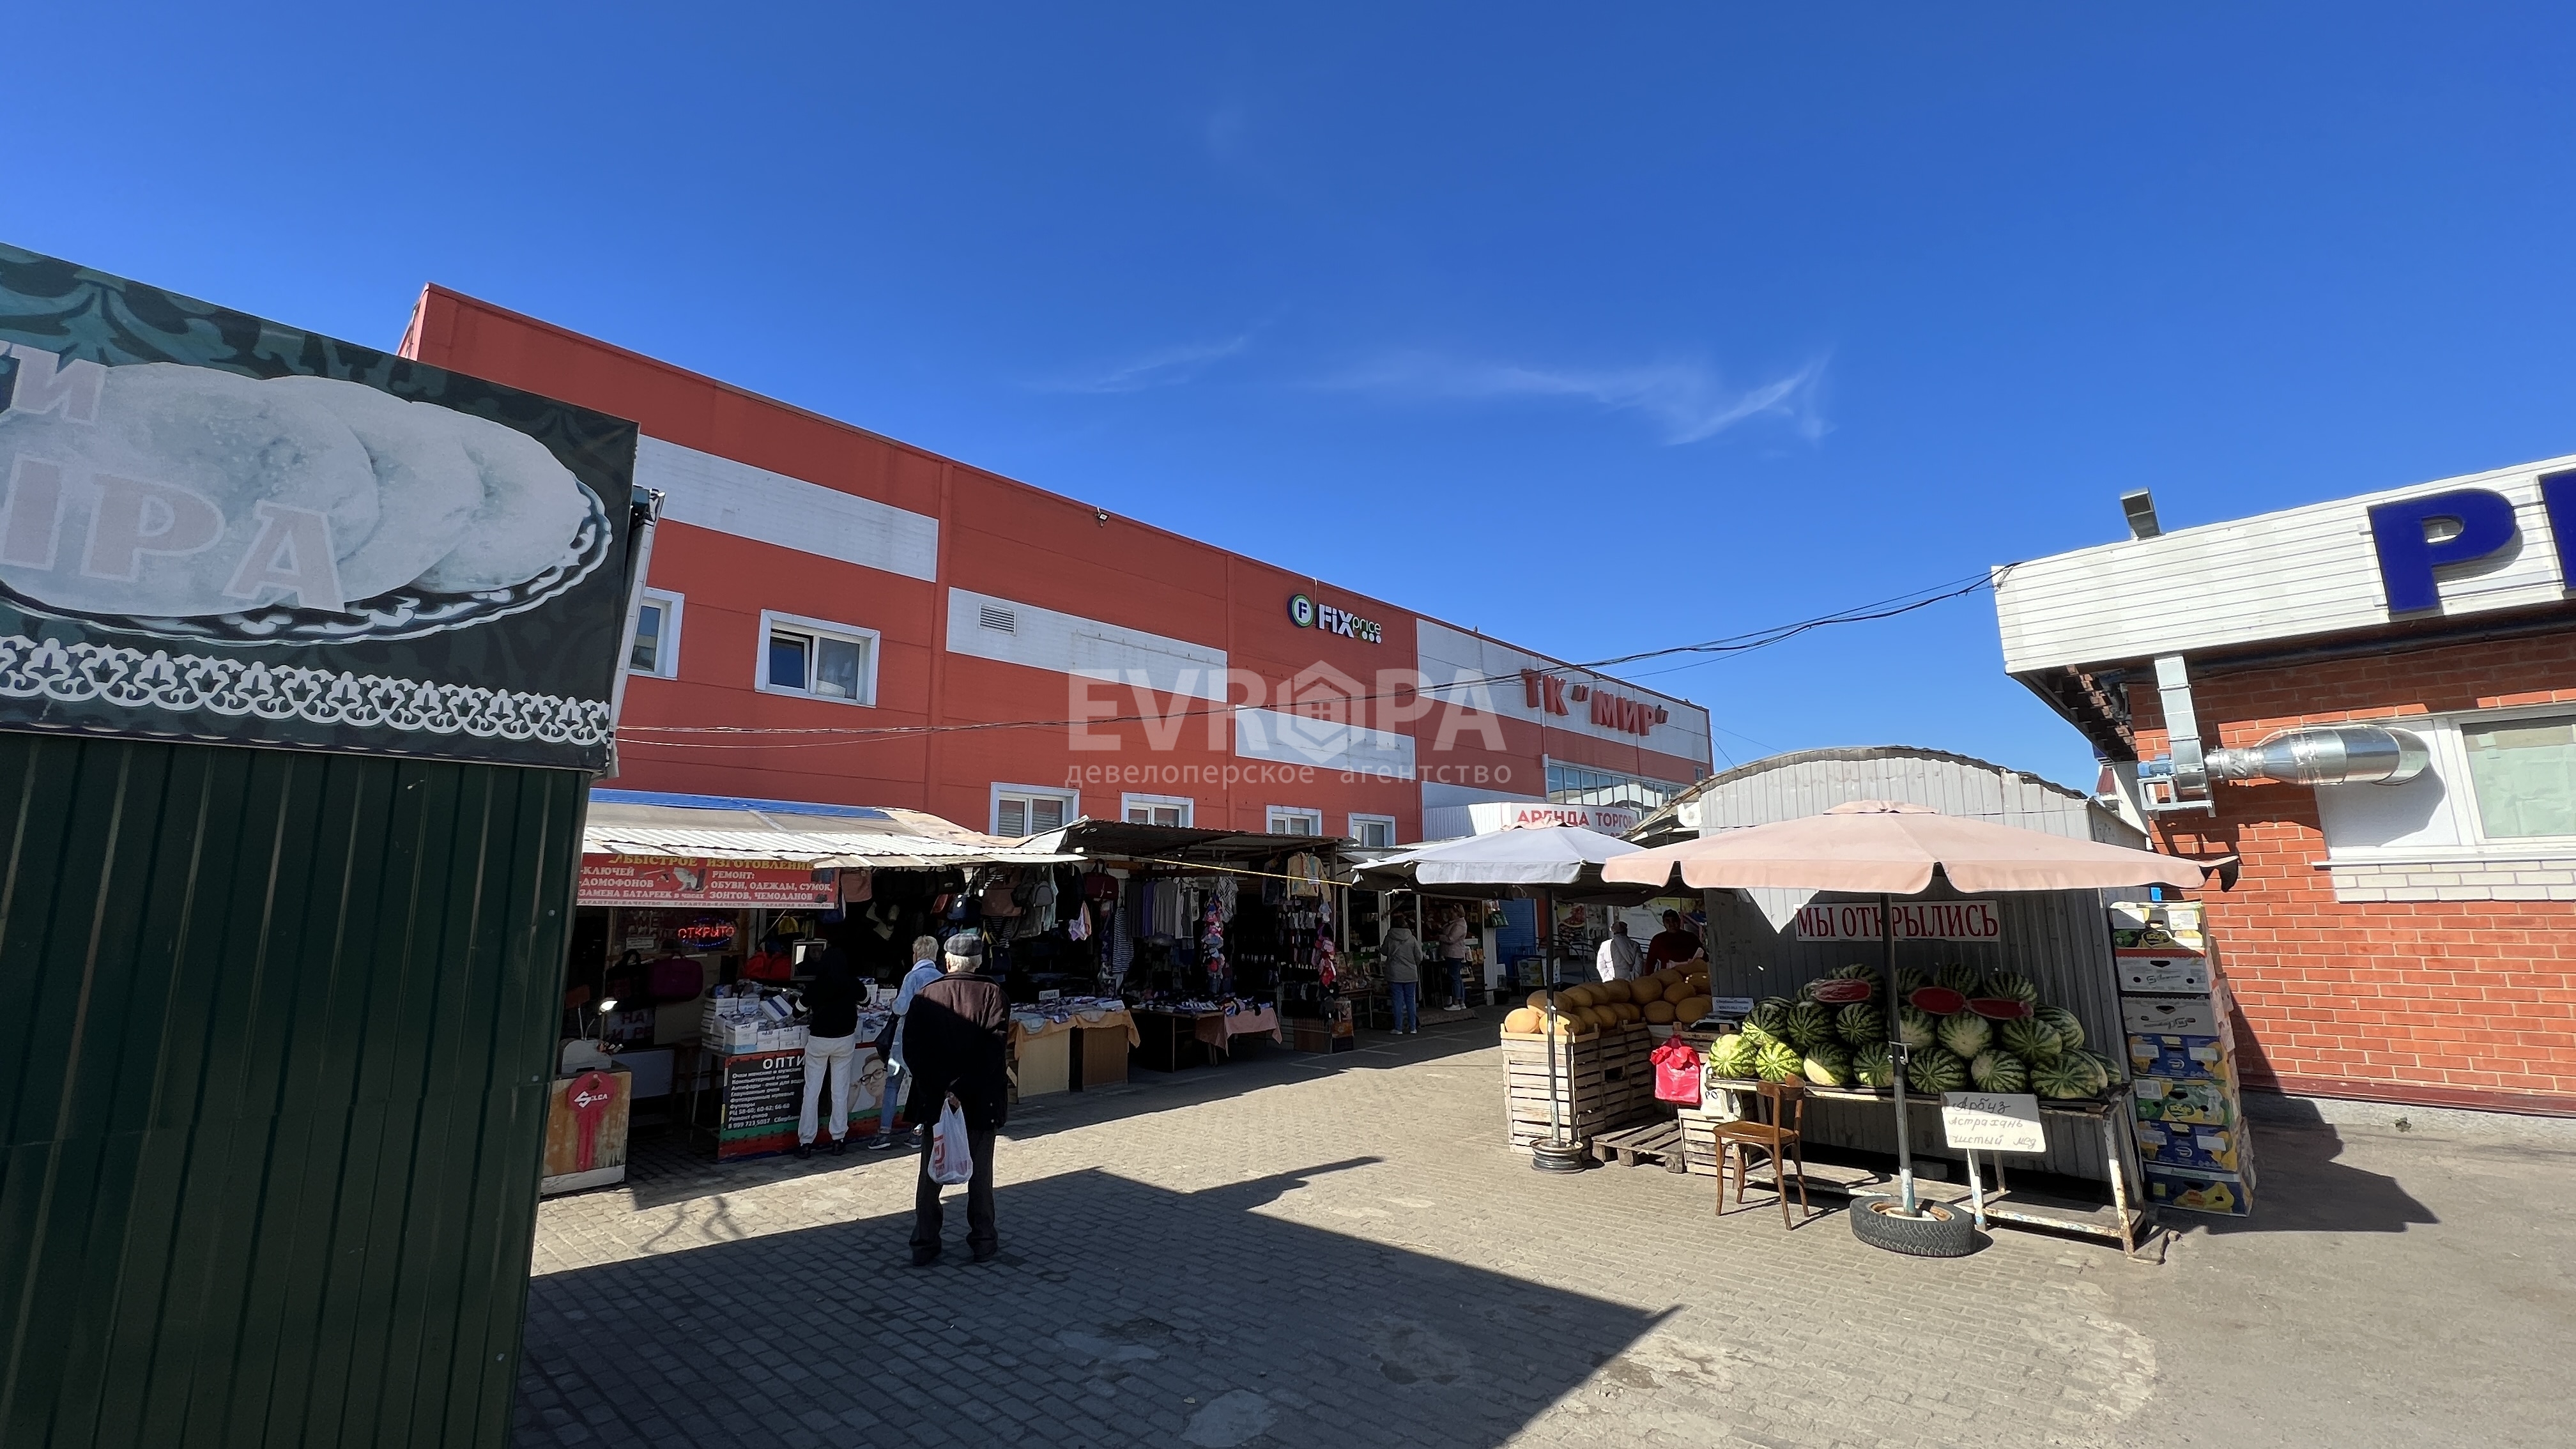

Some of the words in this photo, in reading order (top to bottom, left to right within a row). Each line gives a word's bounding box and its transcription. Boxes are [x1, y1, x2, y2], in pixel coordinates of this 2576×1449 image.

[0, 339, 108, 426] И
[1521, 668, 1569, 716] ТК
[712, 870, 755, 879] РЕМОНТ:
[710, 881, 747, 891] ОБУВИ,
[749, 882, 797, 891] ОДЕЖДЫ,
[799, 883, 833, 892] СУМОК,
[578, 889, 620, 898] ЗАМЕНА
[623, 889, 672, 899] БАТАРЕЕК
[709, 891, 752, 900] ЗОНТОВ,
[755, 892, 813, 901] ЧЕМОДАНОВ
[1795, 907, 1836, 937] МЫ
[1841, 904, 1998, 937] ОТКРЫЛИСЬ
[678, 926, 735, 938] ОТКРЫТО
[1953, 1096, 2011, 1115] Арбуз
